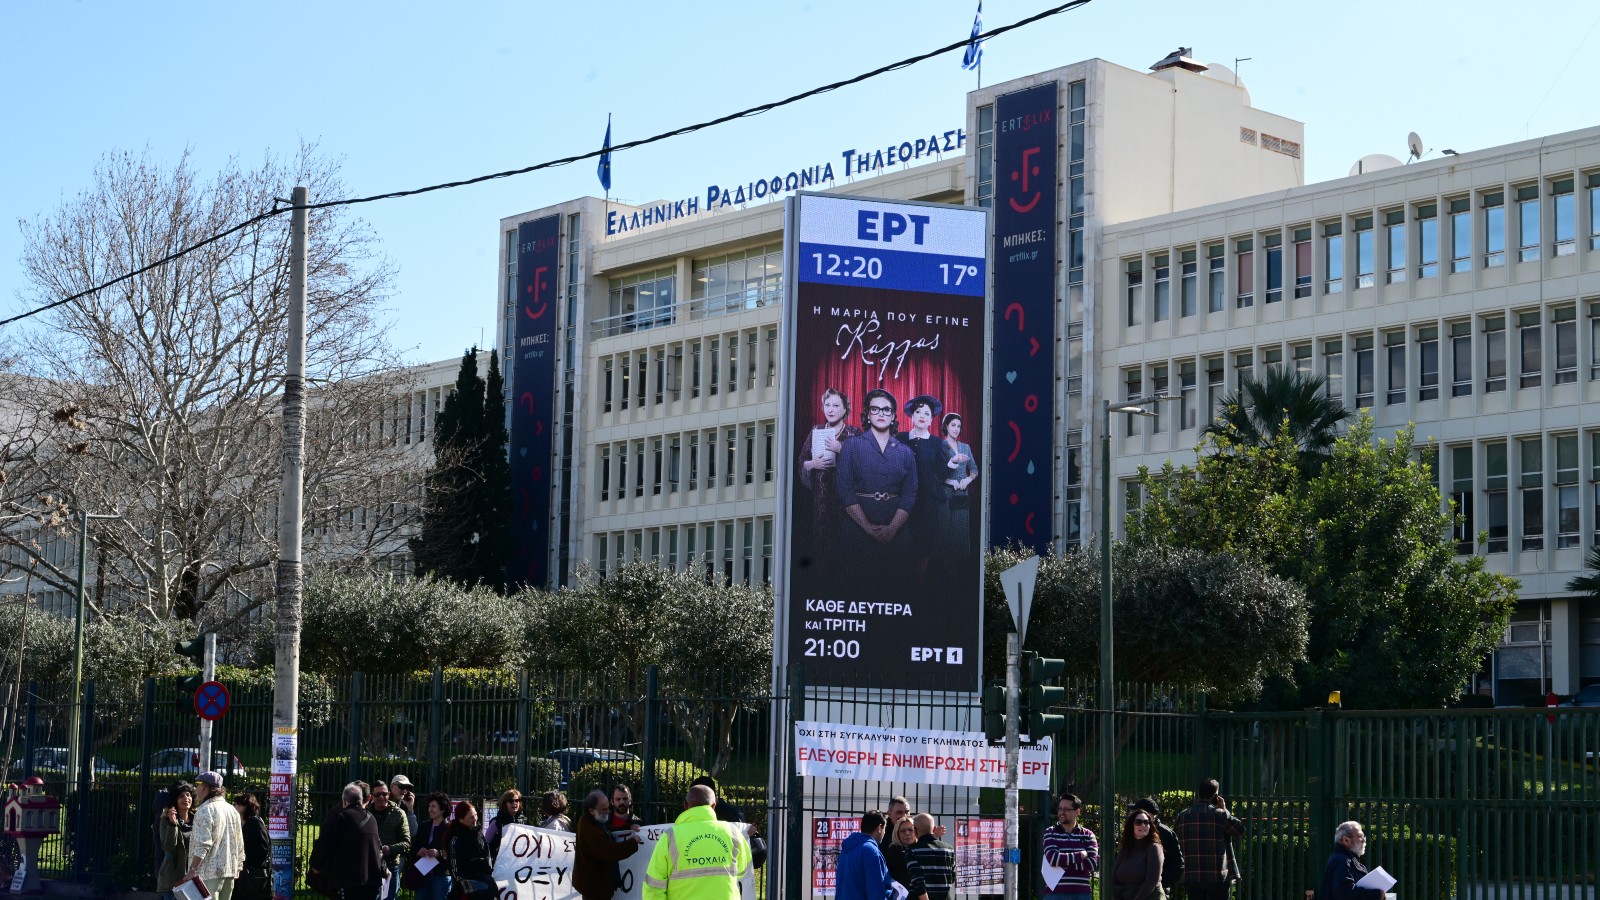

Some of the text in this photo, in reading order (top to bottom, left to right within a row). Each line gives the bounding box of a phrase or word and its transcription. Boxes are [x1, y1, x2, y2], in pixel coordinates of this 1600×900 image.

[1001, 109, 1051, 133] ERTFLIX
[607, 196, 699, 236] ΕΛΛΗΝΙΚΗ
[706, 162, 835, 211] ΡΑΔΙΟΦΩΝΙΑ
[857, 209, 930, 246] ΕΡΤ
[1003, 229, 1046, 248] ΜΠΗΚΕΣ;
[812, 253, 883, 280] 12:20
[1009, 250, 1039, 263] ertflix.gr
[813, 306, 969, 327] Η ΜΑΡΙΑ ΠΟΥ ΕΓΙΝΕ
[805, 599, 913, 616] ΚΑΘΕ ΔΕΥΤΕΡΑ
[805, 618, 866, 632] ΚΑΙ ΤΡΙΤΗ
[804, 638, 860, 659] 21:00
[911, 646, 943, 662] ΕΡΤ
[799, 728, 815, 737] ΟΧΙ
[818, 730, 836, 738] ΣΤΗ
[839, 731, 896, 743] ΣΥΓΚΑΛΥΨΗ
[900, 735, 918, 744] ΤΟΥ
[921, 737, 984, 748] ΕΓΚΛΗΜΑΤΟΣ
[798, 747, 1050, 776] ΕΛΕΥΘΕΡΗ ΕΝΗΜΕΡΩΣΗ ΣΤΗ ΕΡΤ
[817, 821, 828, 833] 28
[831, 820, 859, 830] ΓΕΝΙΚΗ
[512, 833, 576, 859] ΟΧΙ ΣΤ
[686, 856, 727, 866] ΤΡΟΧΑΙΑ
